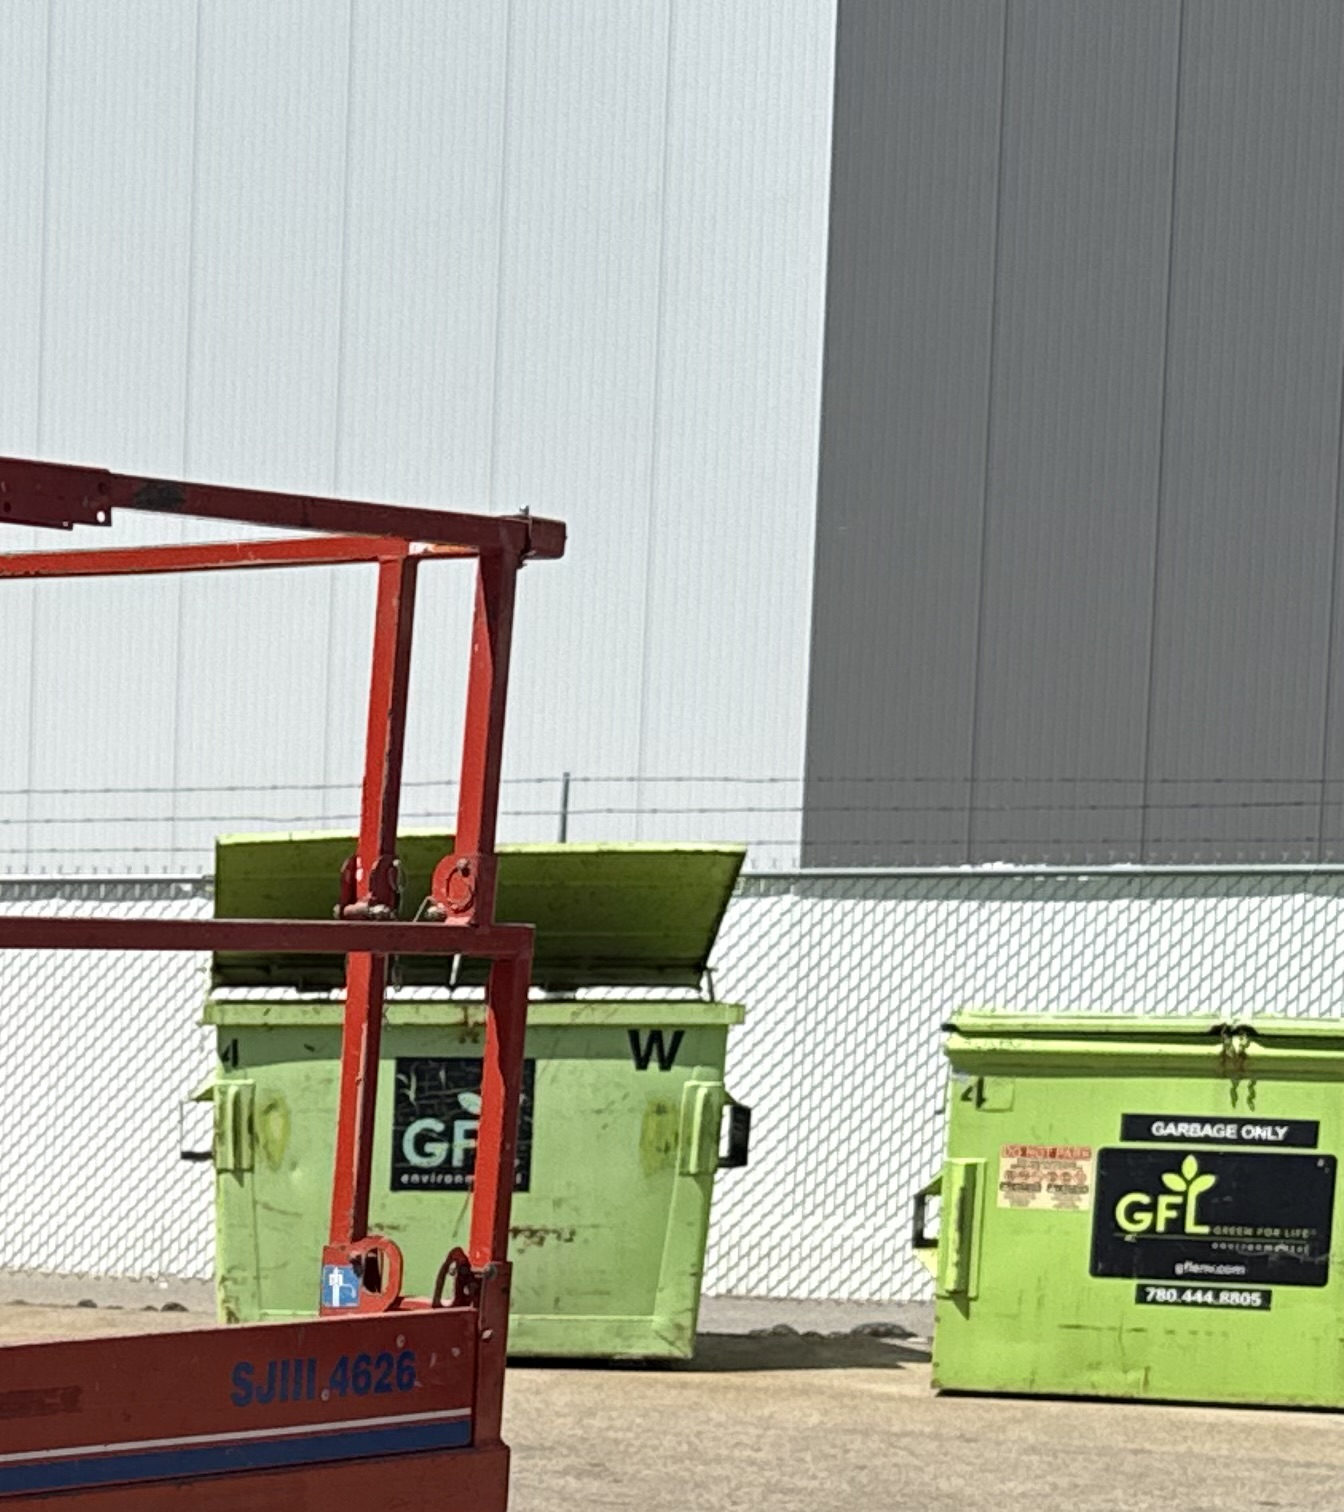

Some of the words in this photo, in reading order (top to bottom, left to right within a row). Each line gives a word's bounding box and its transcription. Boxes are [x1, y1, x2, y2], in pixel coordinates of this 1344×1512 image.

[627, 1028, 686, 1072] W
[1150, 1120, 1238, 1139] GARBAGE
[1241, 1124, 1289, 1142] ONLY
[1115, 1173, 1213, 1234] GFL
[329, 1350, 417, 1397] 4626
